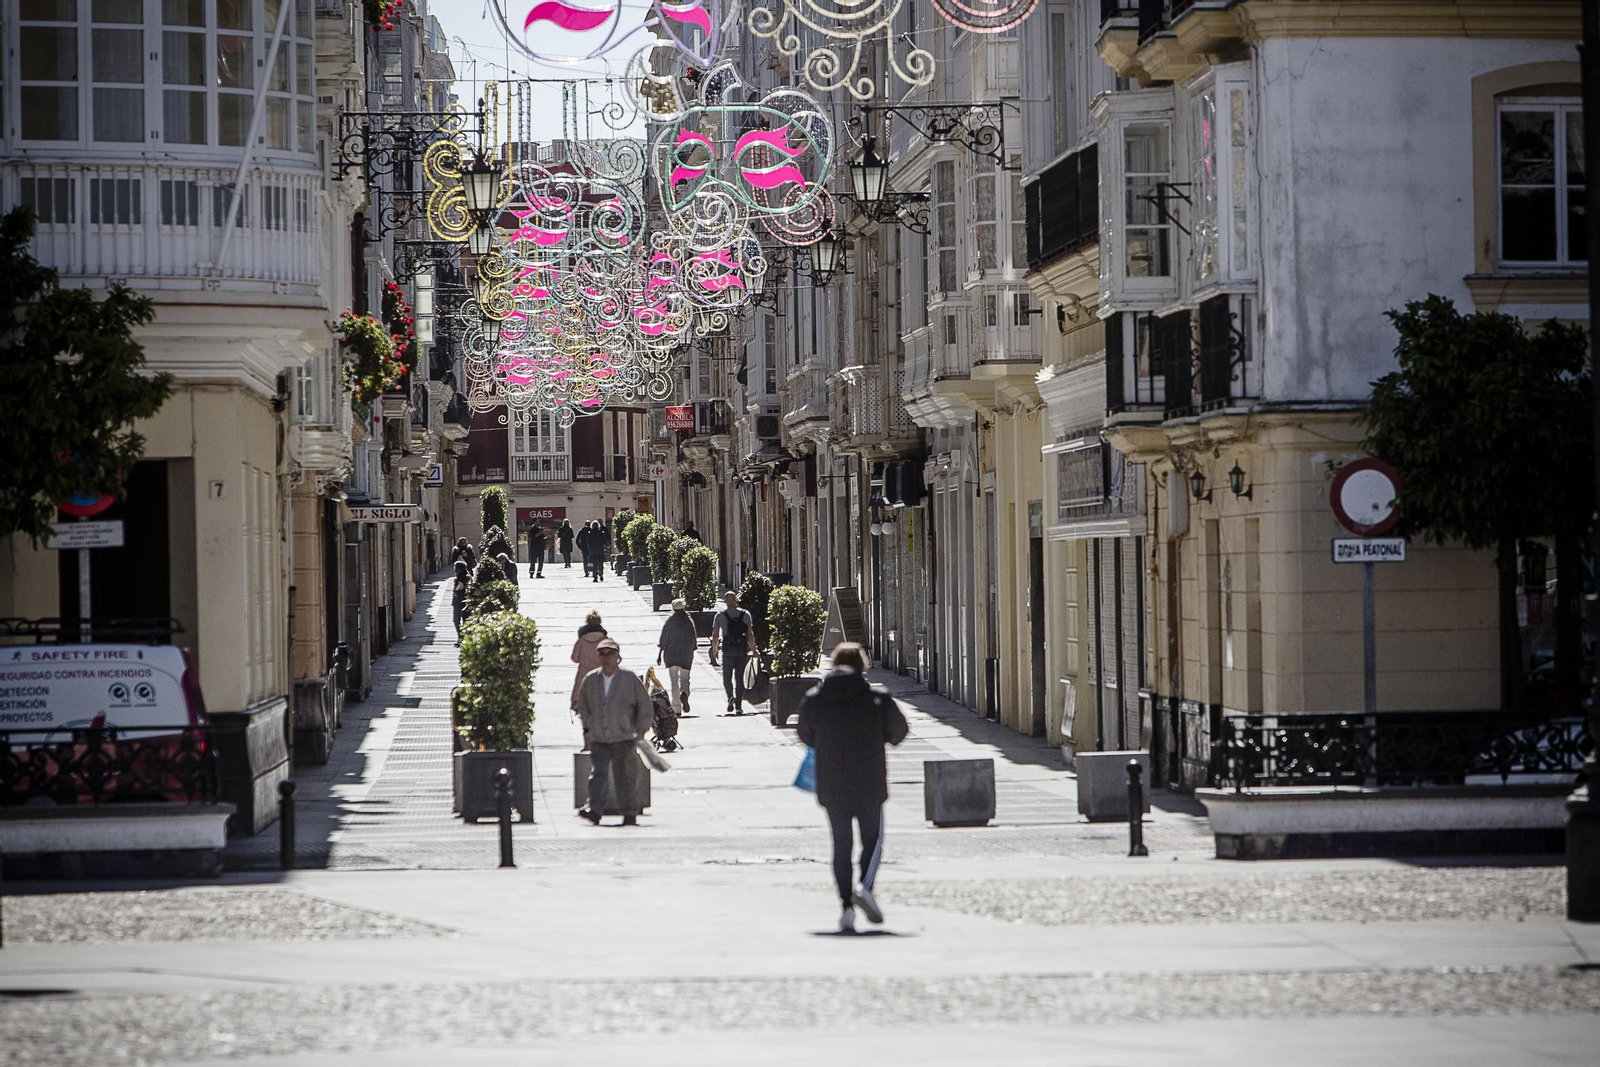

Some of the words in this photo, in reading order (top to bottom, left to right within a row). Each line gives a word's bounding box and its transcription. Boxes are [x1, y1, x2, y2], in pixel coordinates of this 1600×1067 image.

[214, 483, 223, 497] 7
[351, 509, 367, 519] EL
[371, 508, 411, 519] SIGLO
[529, 510, 553, 518] GAES
[1363, 542, 1402, 556] PEATONAL
[31, 650, 89, 661] SAFETY
[94, 650, 128, 660] FIRE
[0, 670, 51, 681] EGURIDAD
[54, 670, 94, 680] CONTRA
[98, 668, 152, 678] INCENDIOS
[0, 685, 49, 698] DETECCIÓN
[0, 698, 47, 710] EXTINCIÓN
[0, 711, 54, 723] PROYECTOS
